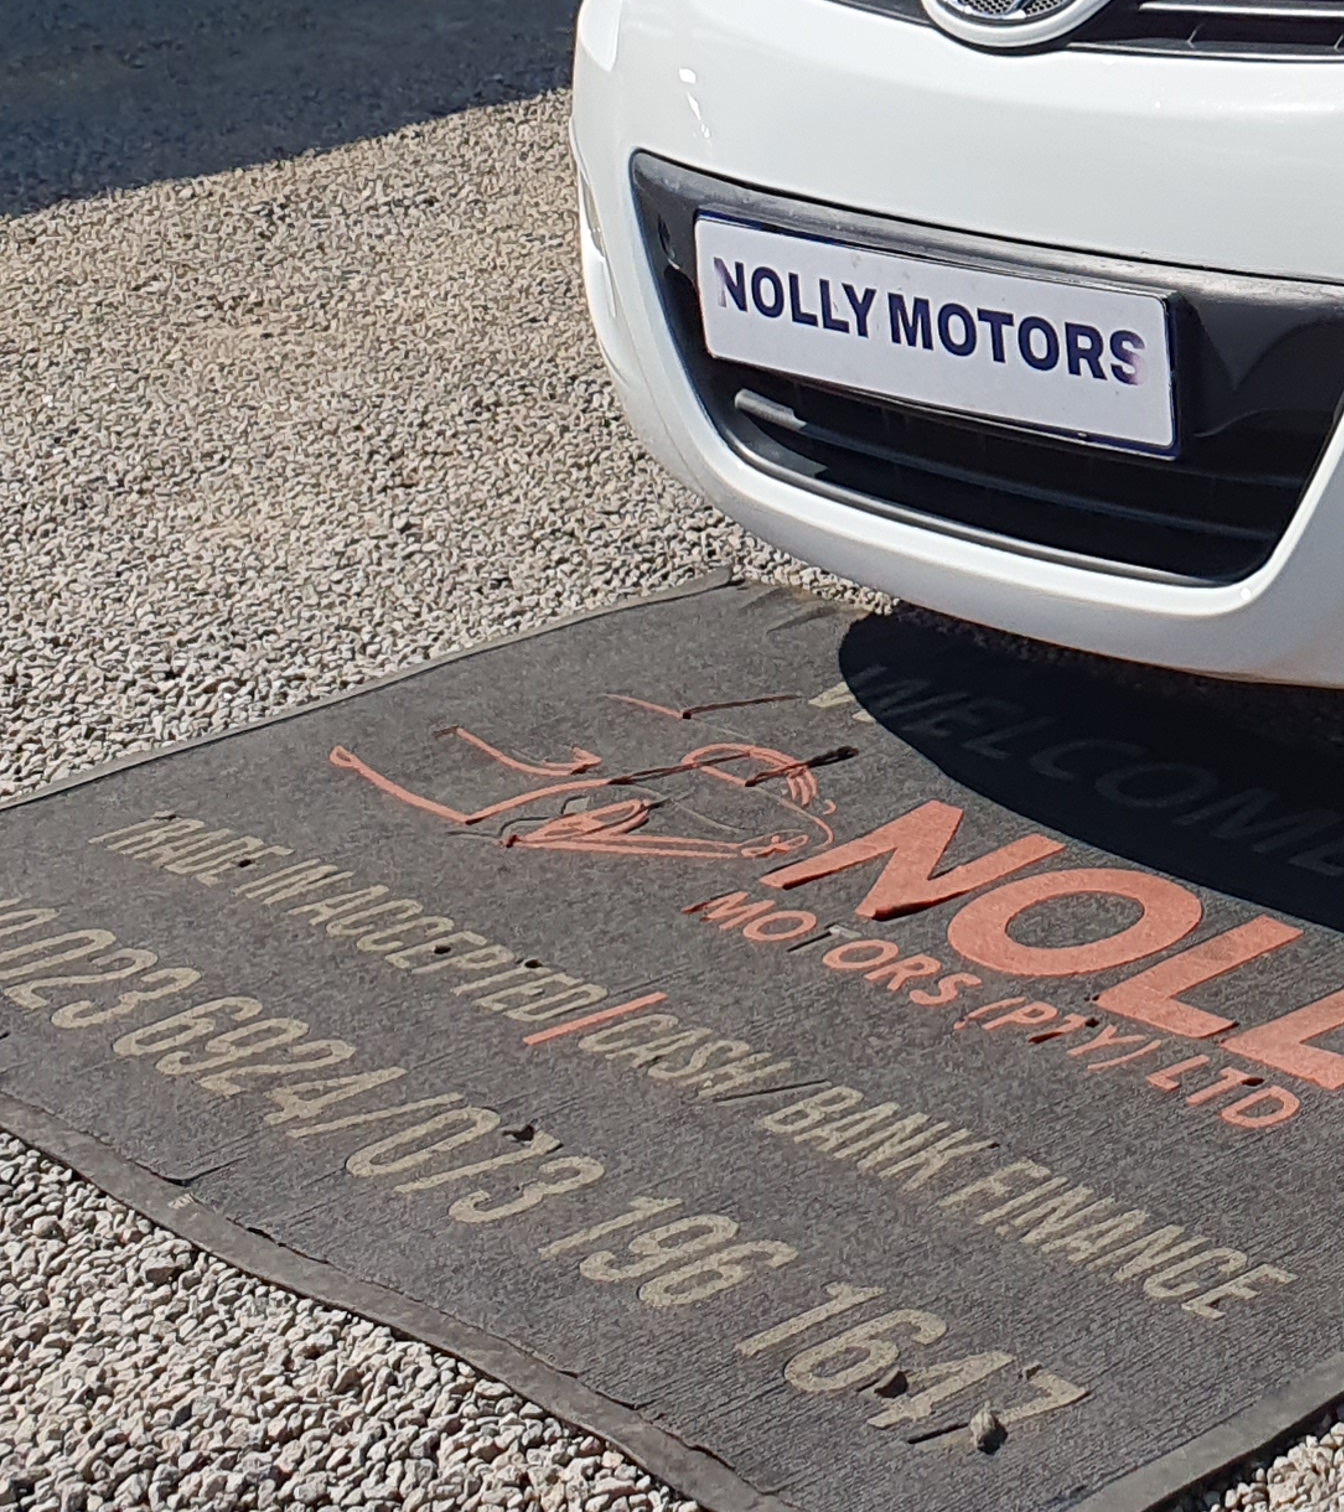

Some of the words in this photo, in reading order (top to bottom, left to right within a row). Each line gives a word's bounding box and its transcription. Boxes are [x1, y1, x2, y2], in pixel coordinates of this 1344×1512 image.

[713, 256, 876, 338] NOLLY
[888, 292, 1146, 386] MOTORS
[88, 811, 294, 887] TRADE
[234, 858, 354, 905] IN
[939, 1158, 1299, 1320] FINANCE
[681, 891, 983, 1006] MOTORS
[953, 996, 1162, 1071] (PTY)
[1146, 1054, 1300, 1129] LTD
[537, 1196, 799, 1307] 196
[735, 1282, 1092, 1448] 1647
